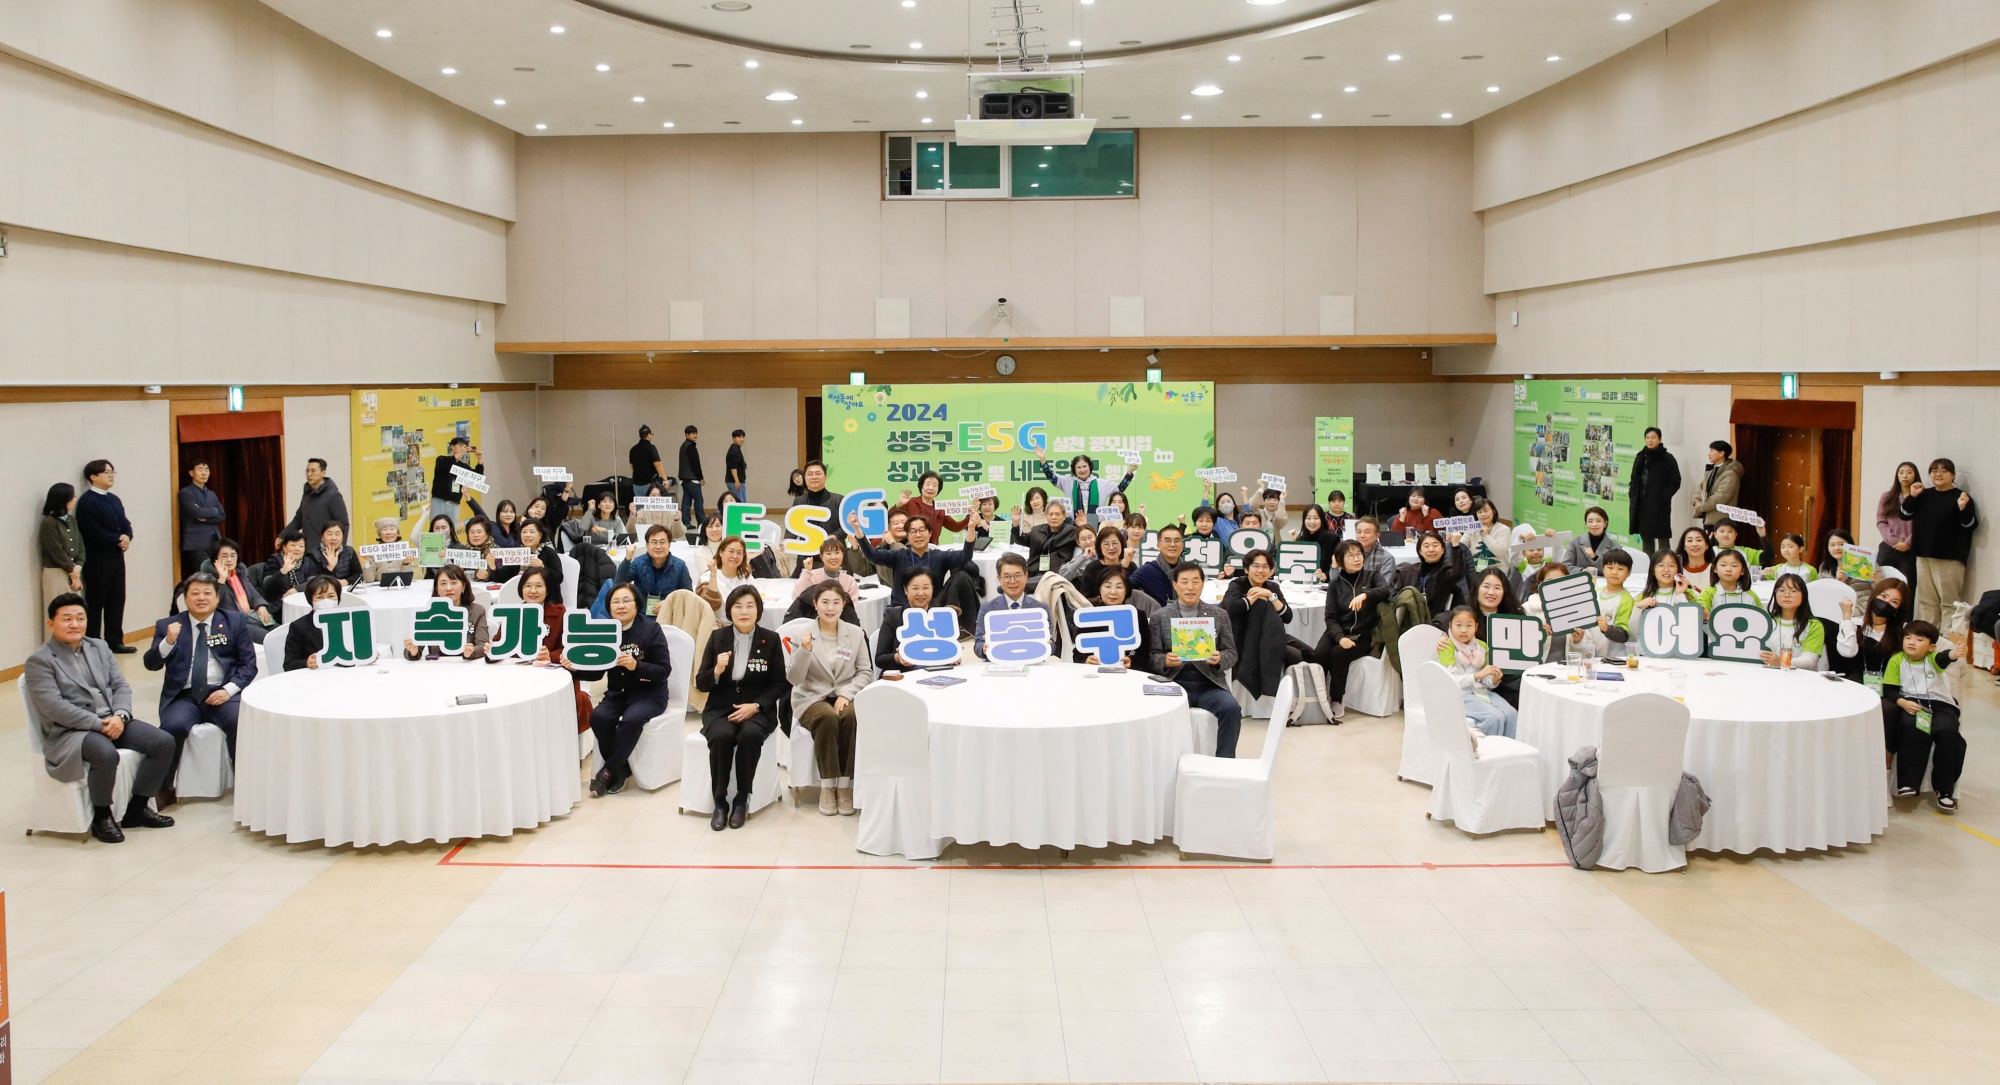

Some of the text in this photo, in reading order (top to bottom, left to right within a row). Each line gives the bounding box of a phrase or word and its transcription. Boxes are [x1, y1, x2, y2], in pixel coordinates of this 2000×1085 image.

[828, 393, 853, 404] #성동에
[1181, 391, 1203, 402] 성동구
[844, 401, 864, 410] 살아요
[887, 403, 947, 421] 2024
[886, 421, 1152, 453] 성동구 ESG 실천 공모사업
[938, 460, 983, 482] 공유
[960, 485, 989, 494] 지속가능도시
[1435, 519, 1450, 527] ESG
[1470, 522, 1481, 530] 미래
[361, 543, 407, 553] ESG 실천으로
[376, 552, 401, 560] 함께하는
